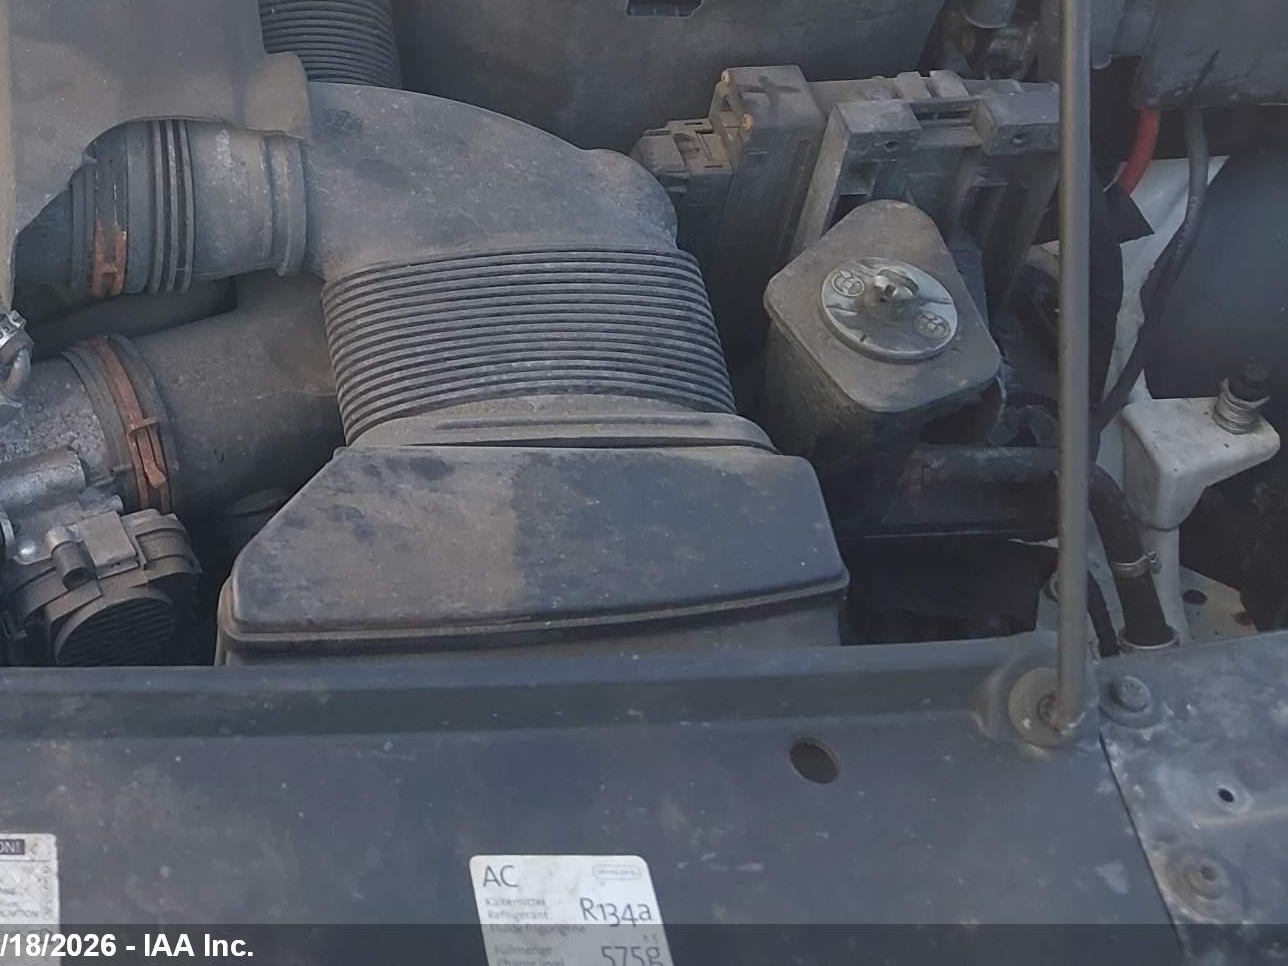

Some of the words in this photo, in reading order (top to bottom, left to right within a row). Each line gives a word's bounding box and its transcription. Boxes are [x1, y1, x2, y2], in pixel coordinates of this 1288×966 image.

[482, 865, 519, 888] AC
[487, 910, 549, 922] Refrigerant
[579, 897, 652, 928] R134a
